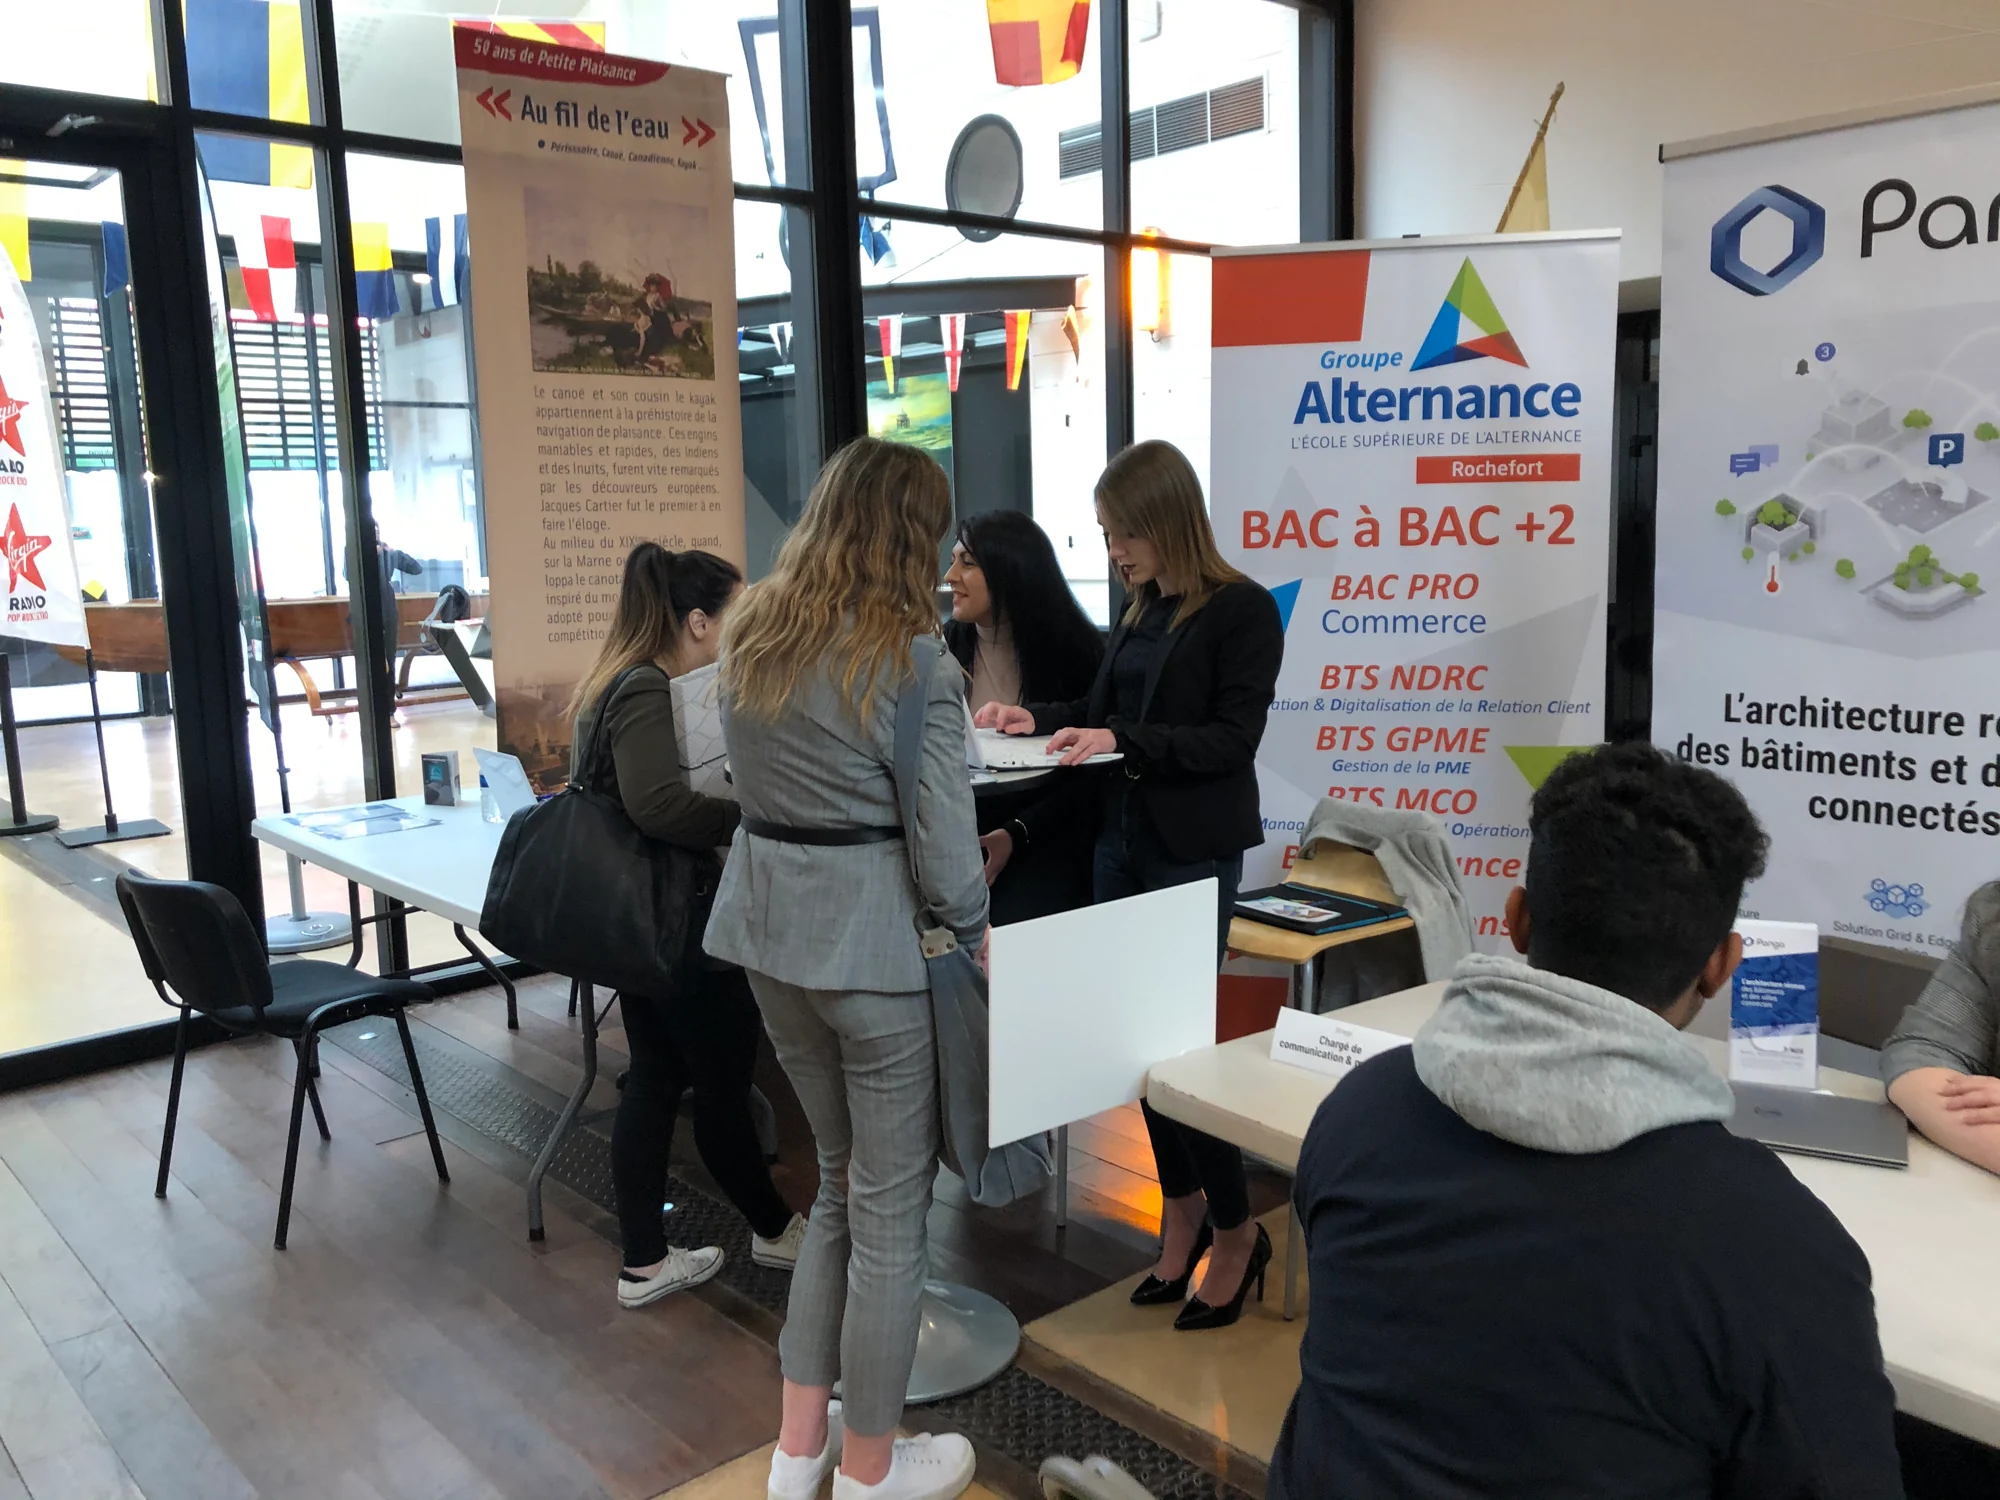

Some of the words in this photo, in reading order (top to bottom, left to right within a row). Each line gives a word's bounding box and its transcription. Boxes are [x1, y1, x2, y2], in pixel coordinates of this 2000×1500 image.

[474, 38, 489, 55] 50
[492, 45, 516, 61] ans
[519, 47, 535, 64] de
[538, 50, 576, 70] Petite
[579, 56, 637, 81] Plaisance
[521, 95, 547, 125] Au
[554, 101, 579, 128] fil
[587, 107, 610, 133] de
[615, 110, 669, 139] l'eau
[1320, 349, 1403, 373] Groupe
[1820, 345, 1831, 359] 3
[534, 384, 545, 398] Le
[593, 388, 604, 400] et
[611, 391, 628, 401] son
[634, 389, 670, 402] cousin
[675, 391, 684, 403] le
[689, 393, 717, 407] kayak
[1293, 376, 1582, 425] Alternance
[536, 406, 613, 422] appartiennent
[616, 406, 622, 420] à
[625, 407, 634, 420] la
[636, 408, 692, 423] préhistoire
[695, 409, 705, 422] de
[708, 410, 717, 423] la
[536, 425, 594, 440] navigation
[596, 425, 610, 437] de
[669, 426, 687, 439] Ces
[687, 430, 718, 443] engins
[1291, 431, 1348, 450] L'ÉCOLE
[1353, 429, 1445, 448] SUPÉRIEURE
[1450, 431, 1470, 445] DE
[1476, 428, 1582, 445] L'ALTERNANCE
[538, 444, 593, 456] maniables
[598, 445, 610, 456] et
[615, 445, 657, 459] rapides,
[663, 445, 681, 457] des
[685, 445, 718, 459] Indiens
[1938, 439, 1956, 459] P
[539, 463, 549, 474] et
[552, 463, 570, 475] des
[573, 463, 609, 477] Inuits,
[613, 463, 644, 476] furent
[647, 464, 667, 476] vite
[670, 464, 720, 478] remarqués
[1452, 459, 1544, 478] Rochefort
[540, 483, 556, 496] par
[565, 481, 582, 494] les
[592, 481, 658, 494] découvreurs
[541, 499, 581, 514] Jacques
[585, 499, 622, 512] Cartier
[627, 499, 640, 512] fut
[644, 499, 655, 512] le
[659, 500, 698, 514] premier
[701, 500, 706, 512] à
[709, 503, 721, 512] en
[543, 518, 566, 530] faire
[569, 518, 611, 533] l'éloge.
[1242, 507, 1339, 549] BAC
[1353, 504, 1380, 548] à
[1400, 504, 1500, 547] BAC
[1515, 503, 1576, 545] +2
[8, 530, 43, 573] Virgin
[543, 537, 556, 549] Au
[560, 536, 594, 549] milieu
[600, 536, 614, 548] du
[691, 535, 722, 548] quand,
[544, 557, 560, 568] sur
[563, 555, 572, 568] la
[577, 555, 612, 568] Marne
[545, 574, 573, 589] loppa
[576, 574, 585, 586] le
[1331, 574, 1399, 600] BAC
[1407, 573, 1480, 600] PRO
[9, 594, 46, 611] RADIO
[546, 592, 582, 607] inspiré
[584, 592, 599, 604] du
[601, 594, 619, 604] mo
[547, 611, 583, 626] adopté
[1322, 609, 1487, 634] Commerce
[548, 628, 606, 643] compétitio
[1320, 664, 1380, 690] BTS
[1389, 664, 1489, 691] NDRC
[1270, 697, 1309, 711] ation
[1313, 698, 1325, 711] &
[1329, 697, 1431, 715] Digitalisation
[1435, 698, 1454, 713] de
[1458, 698, 1473, 713] la
[1477, 699, 1542, 714] Relation
[1547, 699, 1591, 715] Client
[1724, 691, 1965, 737] L'architecture
[1979, 712, 2000, 738] r
[1316, 725, 1376, 752] BTS
[1386, 726, 1490, 753] GPME
[1332, 758, 1389, 774] Gestion
[1394, 759, 1412, 774] de
[1417, 760, 1430, 774] la
[1435, 761, 1471, 775] PME
[1677, 732, 1730, 766] des
[1741, 736, 1917, 781] bâtiments
[1930, 755, 1968, 785] et
[1395, 788, 1478, 815] MCO
[1261, 817, 1305, 834] anag
[1808, 796, 2000, 837] connectés
[1451, 822, 1531, 838] Opération
[1833, 920, 1883, 938] Solution
[1886, 928, 1912, 942] Grid
[1915, 934, 1924, 944] &
[1279, 1040, 1344, 1064] communication
[1345, 1056, 1352, 1066] &
[1319, 1035, 1350, 1053] Chargé
[1351, 1043, 1363, 1055] de
